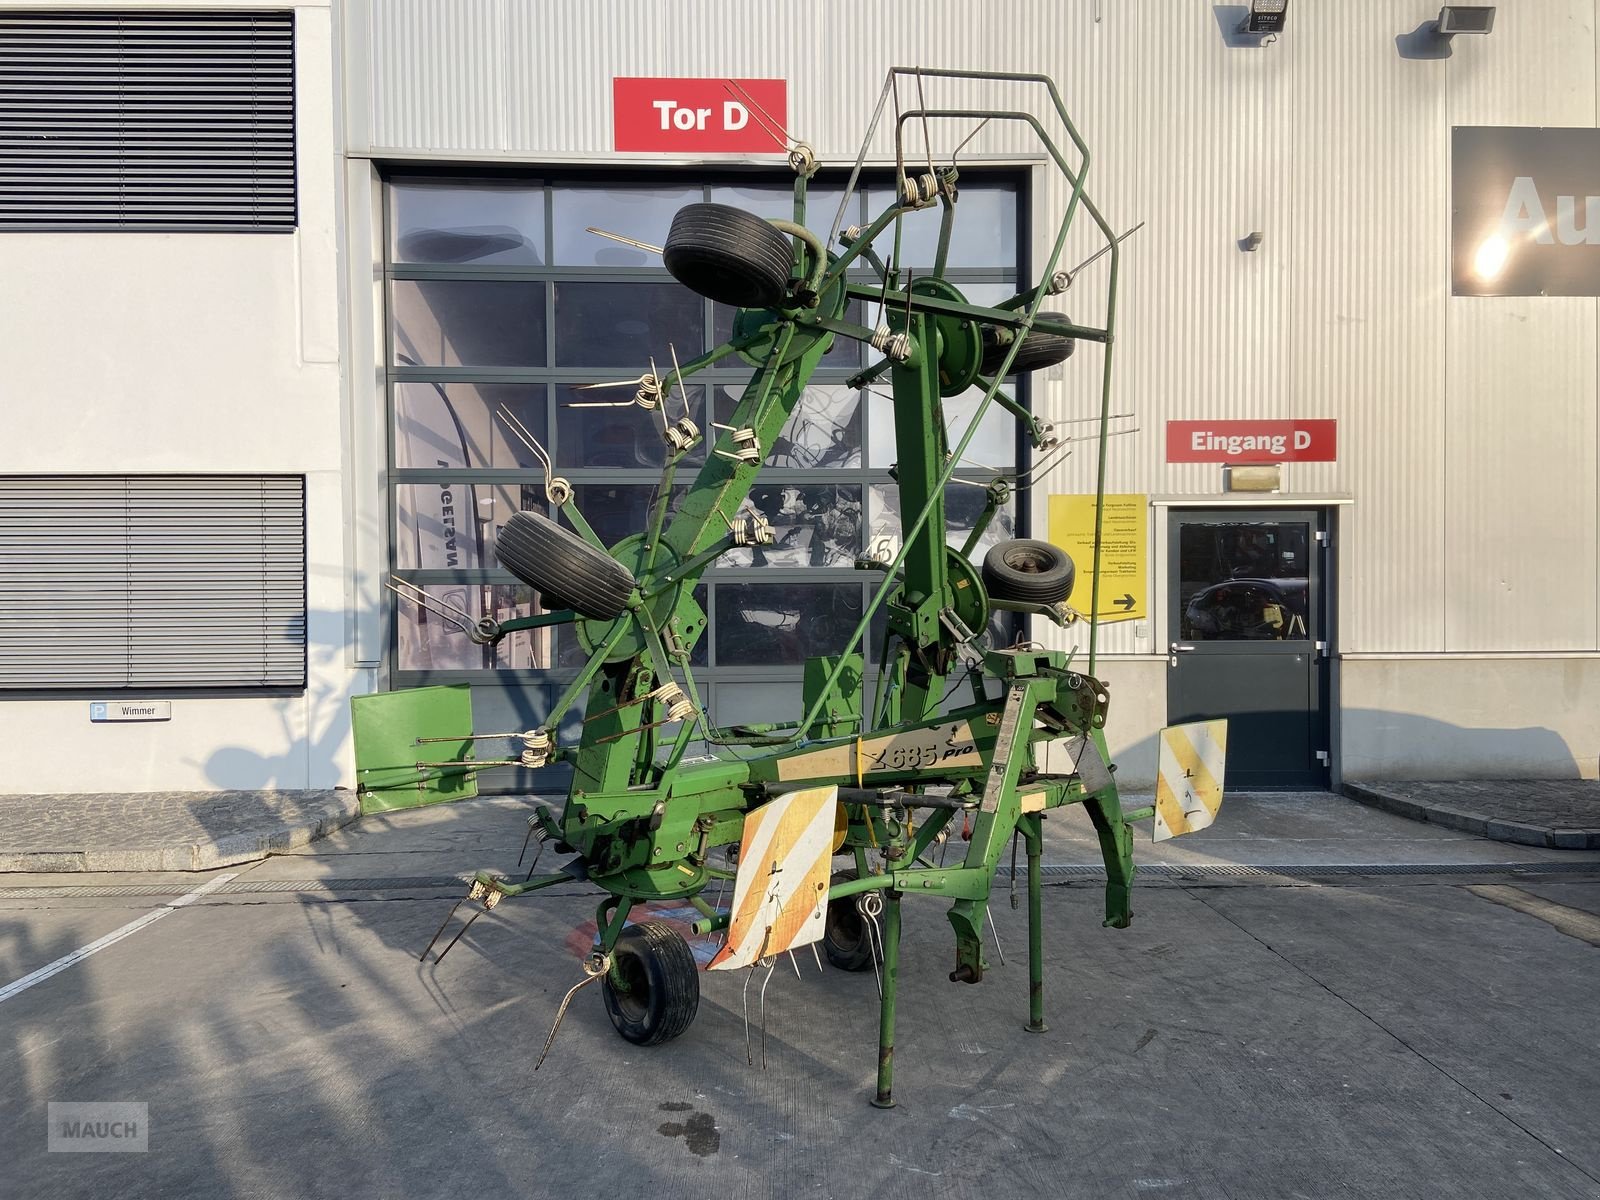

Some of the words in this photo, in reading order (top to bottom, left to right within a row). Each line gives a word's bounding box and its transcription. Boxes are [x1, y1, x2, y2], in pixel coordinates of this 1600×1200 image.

[652, 100, 712, 130] Tor
[723, 101, 749, 131] D
[1191, 431, 1287, 455] Eingang
[1294, 430, 1312, 450] D
[121, 706, 156, 715] Wimmer
